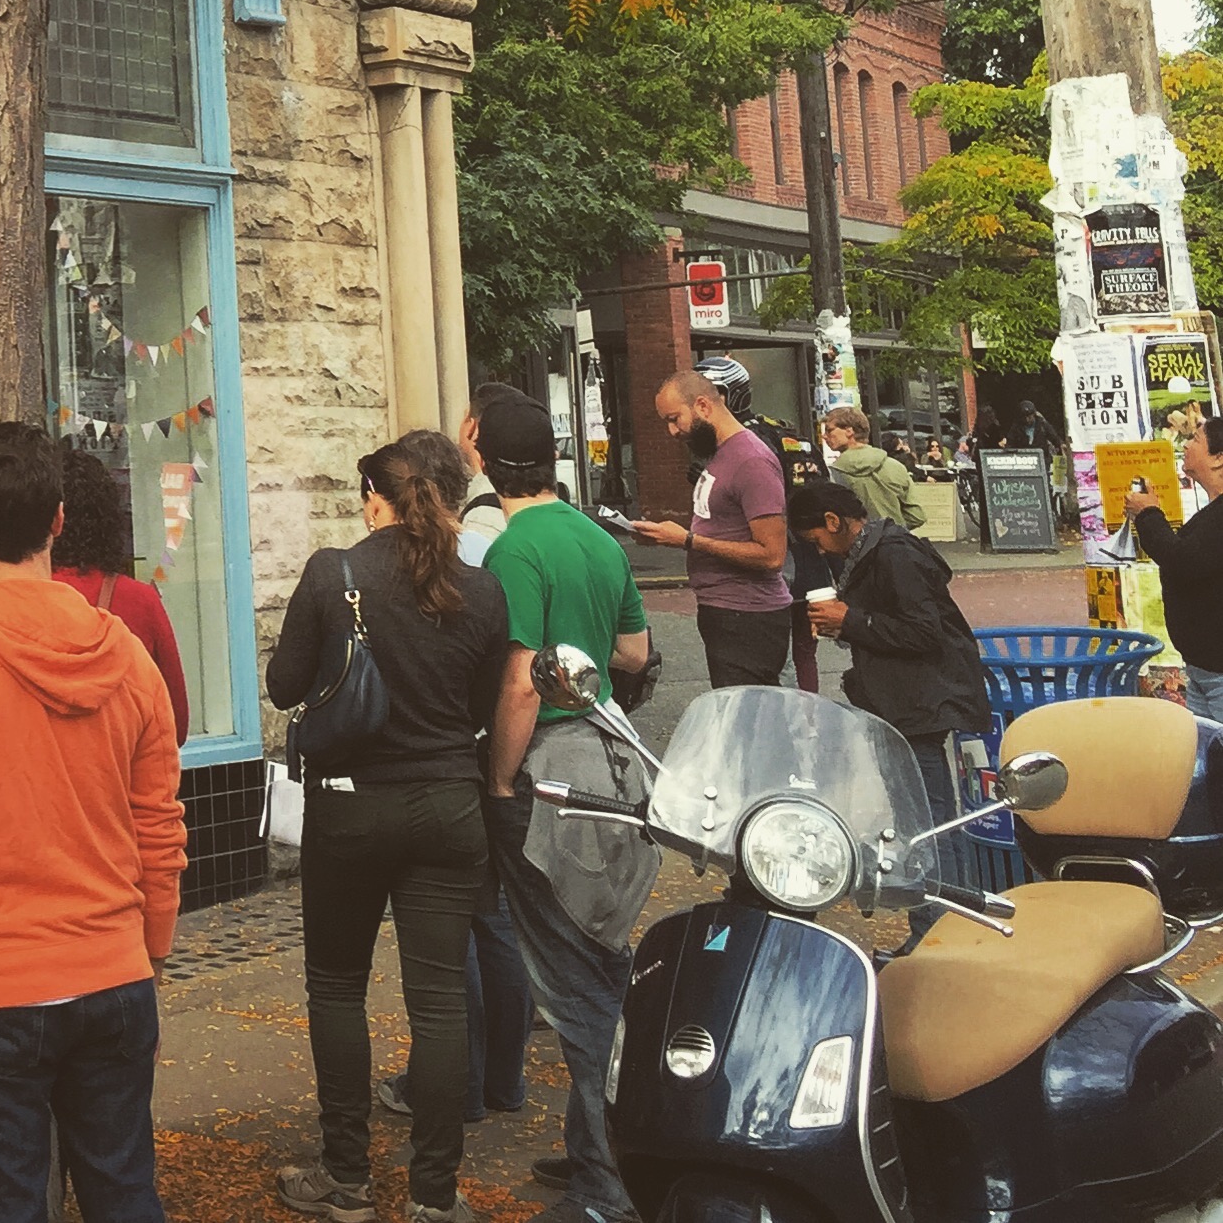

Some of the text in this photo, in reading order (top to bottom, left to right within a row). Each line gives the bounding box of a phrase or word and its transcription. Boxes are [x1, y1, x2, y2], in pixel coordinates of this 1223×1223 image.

[1104, 273, 1156, 284] SURFACE
[1107, 282, 1155, 293] THEORY
[695, 308, 722, 318] miro
[1148, 352, 1204, 368] SERIAL
[1150, 366, 1205, 382] HAWK
